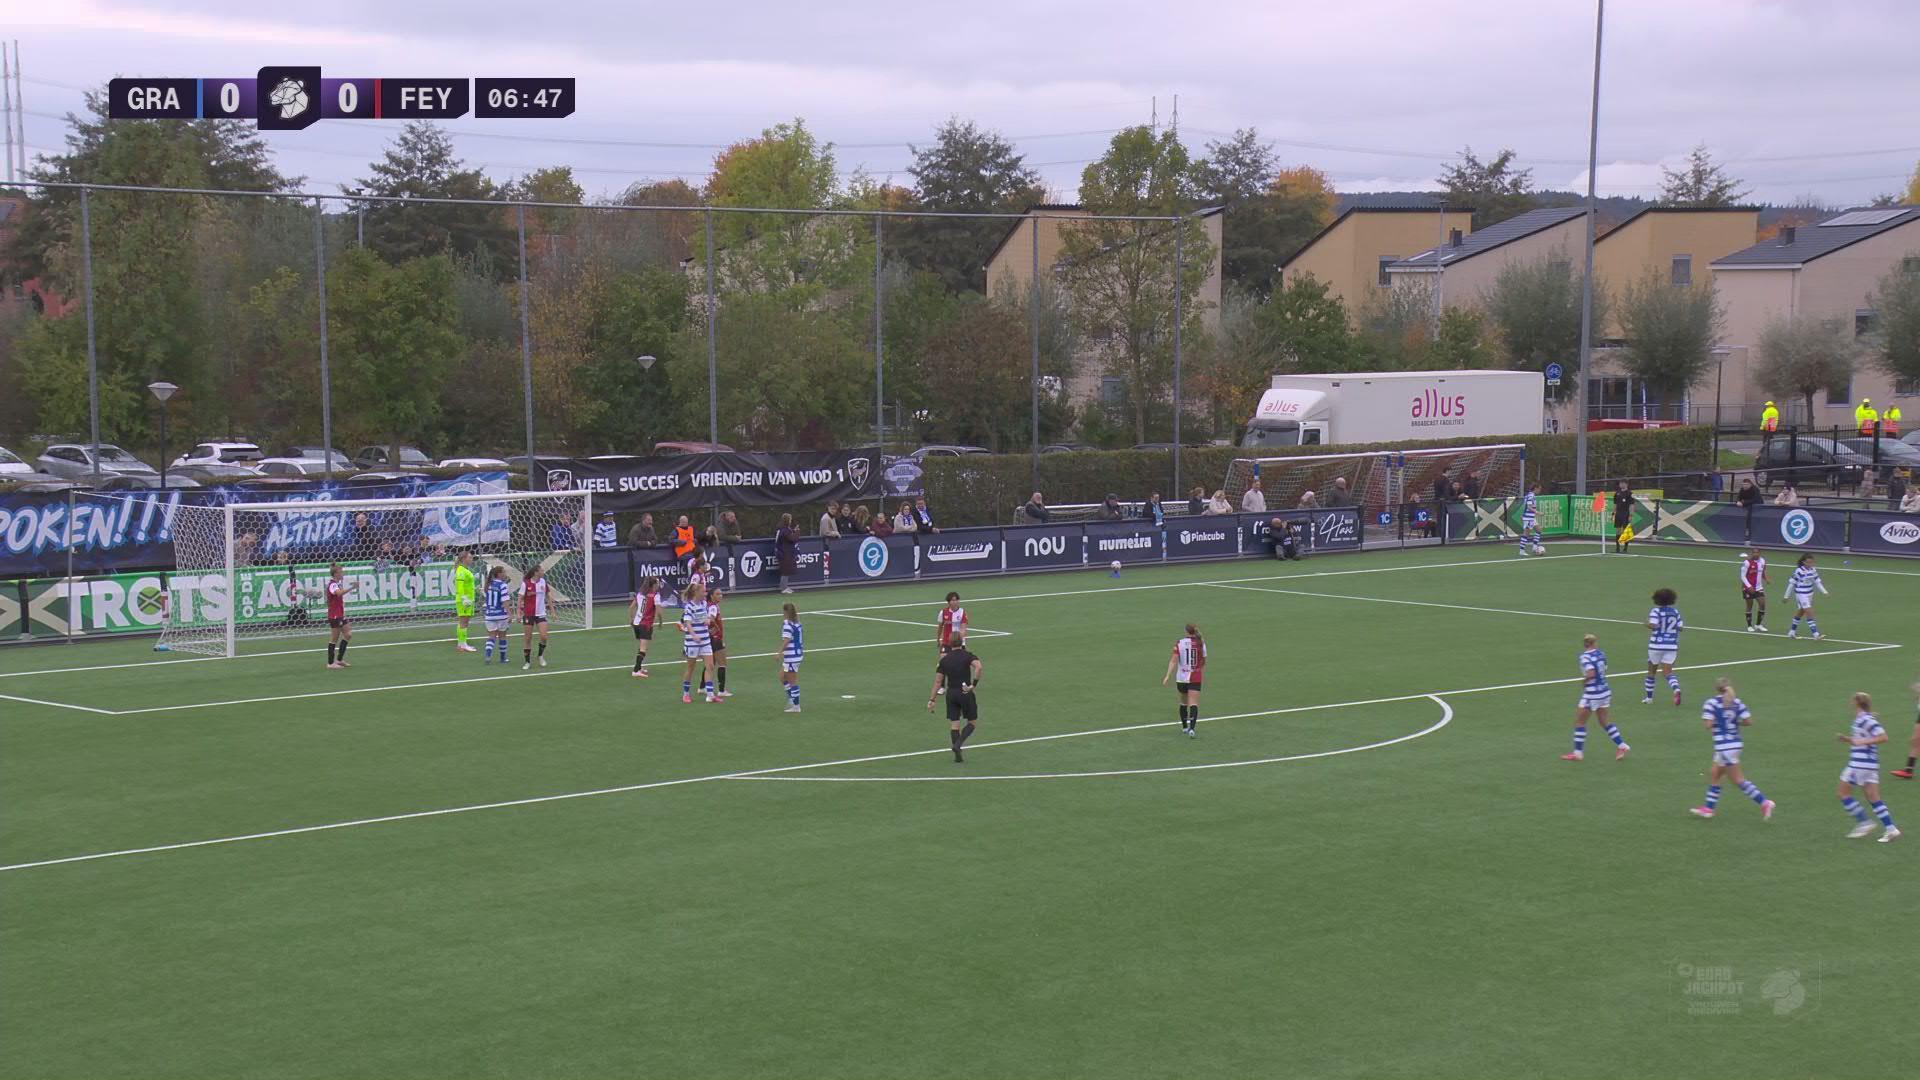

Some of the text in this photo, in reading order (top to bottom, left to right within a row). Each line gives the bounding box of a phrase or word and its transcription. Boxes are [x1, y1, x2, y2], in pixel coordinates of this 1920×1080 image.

[1265, 399, 1299, 413] allus
[1412, 389, 1465, 418] allus
[577, 477, 614, 493] VEEL
[619, 474, 680, 492] SUCCES!
[690, 472, 763, 488] VRIENDEN
[768, 471, 797, 486] VAN
[800, 469, 833, 485] VIOD
[1191, 531, 1225, 542] Pinkcube
[1883, 525, 1919, 538] Aviko
[1025, 536, 1065, 557] nou
[1099, 532, 1152, 551] numeira
[57, 573, 229, 629] TROTS
[1660, 616, 1677, 634] 12
